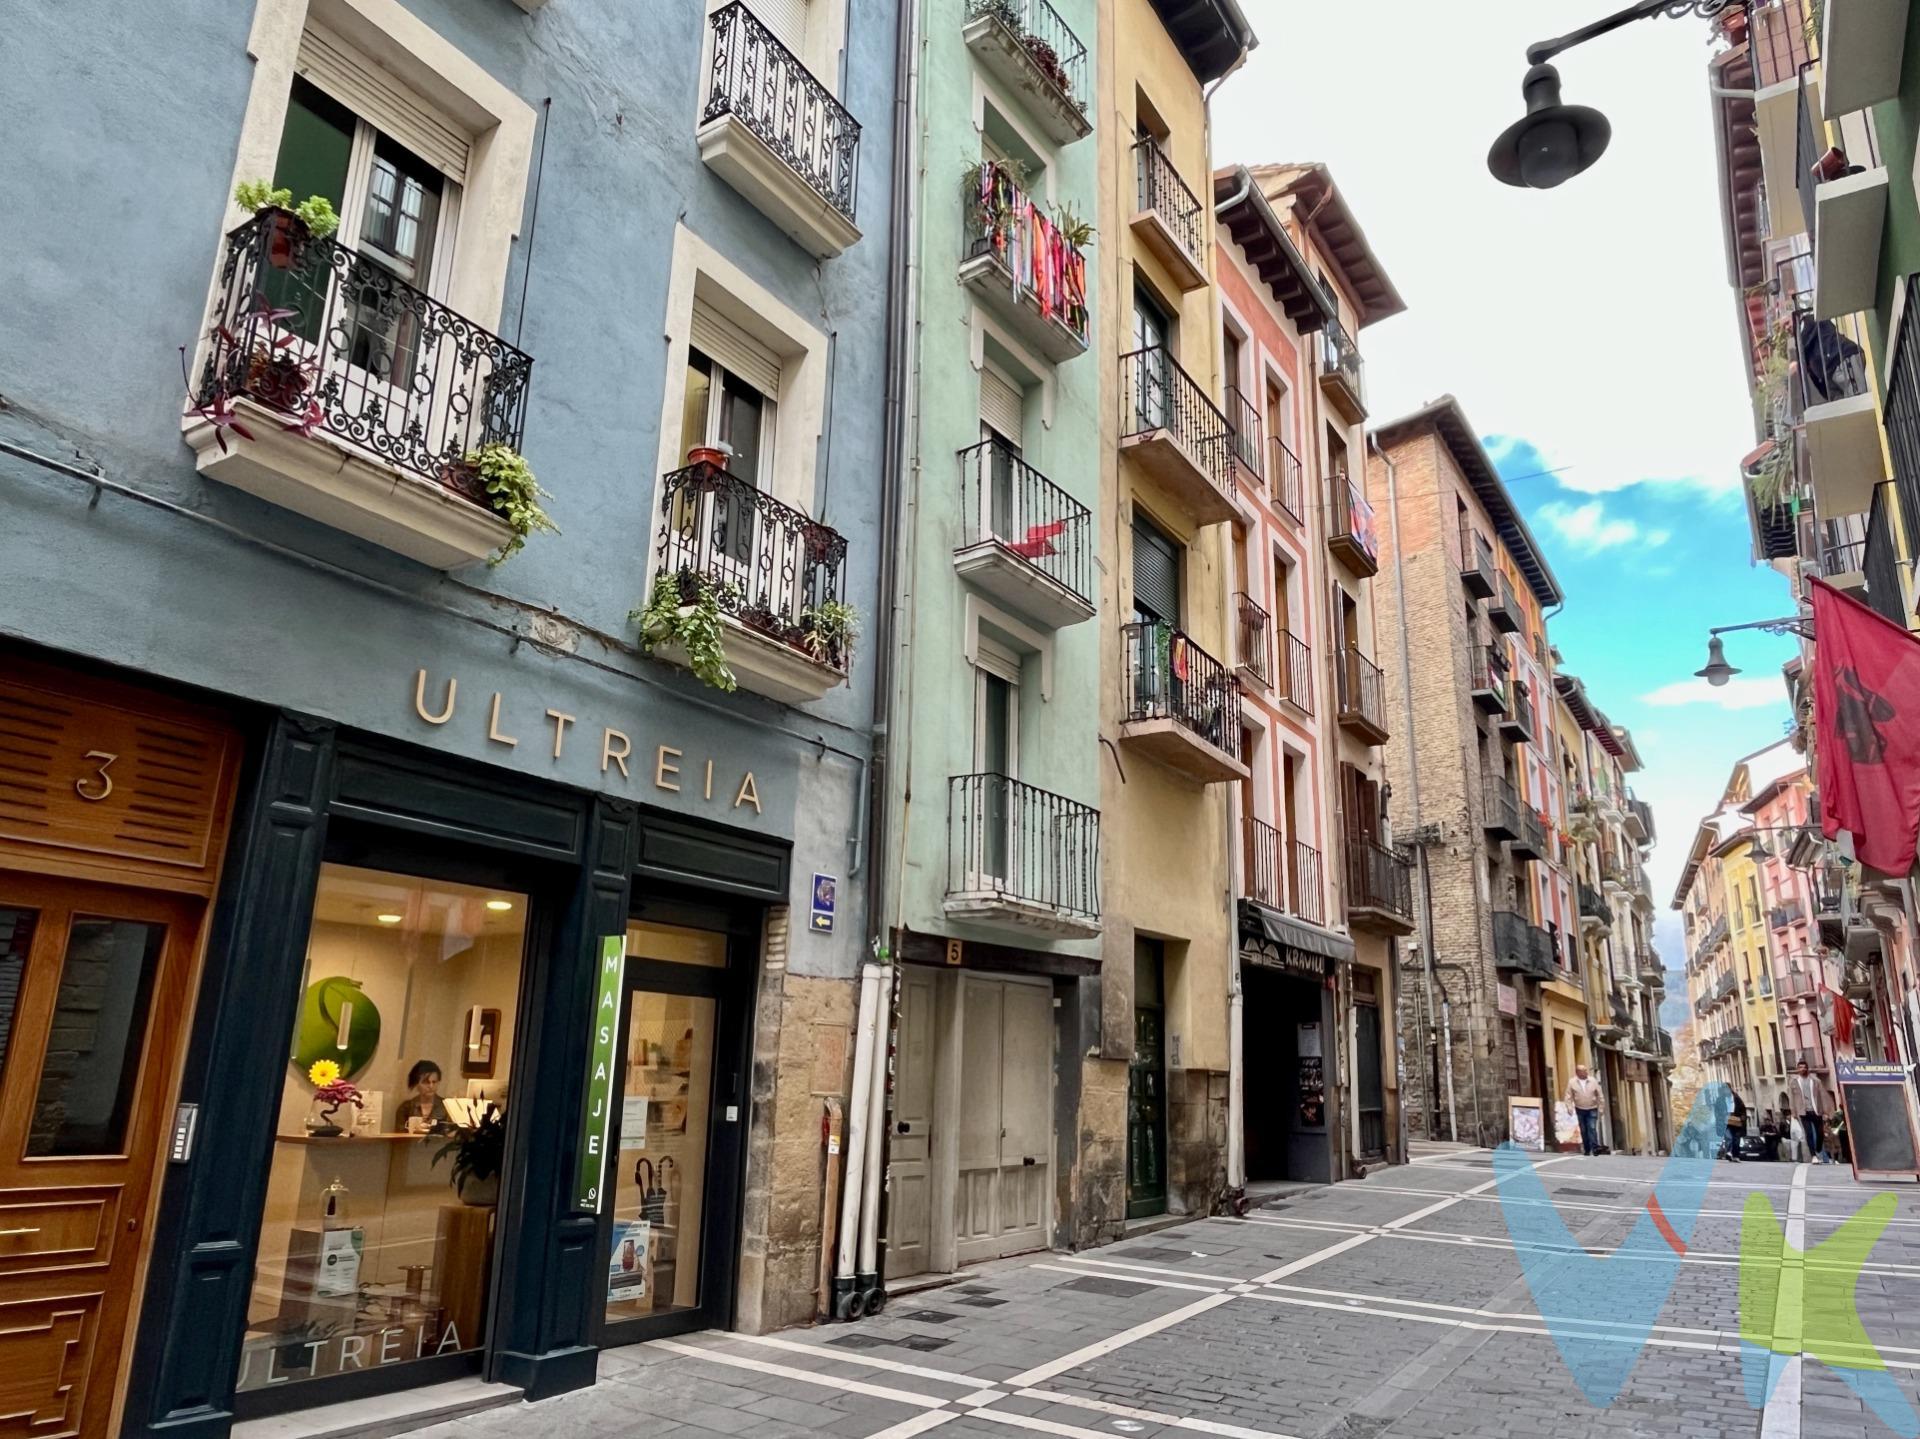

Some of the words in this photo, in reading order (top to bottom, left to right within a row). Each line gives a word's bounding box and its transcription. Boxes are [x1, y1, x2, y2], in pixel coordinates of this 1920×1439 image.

[76, 749, 119, 800] 3
[415, 668, 762, 815] ULTREIA
[950, 943, 960, 961] 5
[587, 954, 618, 1155] MASAJE
